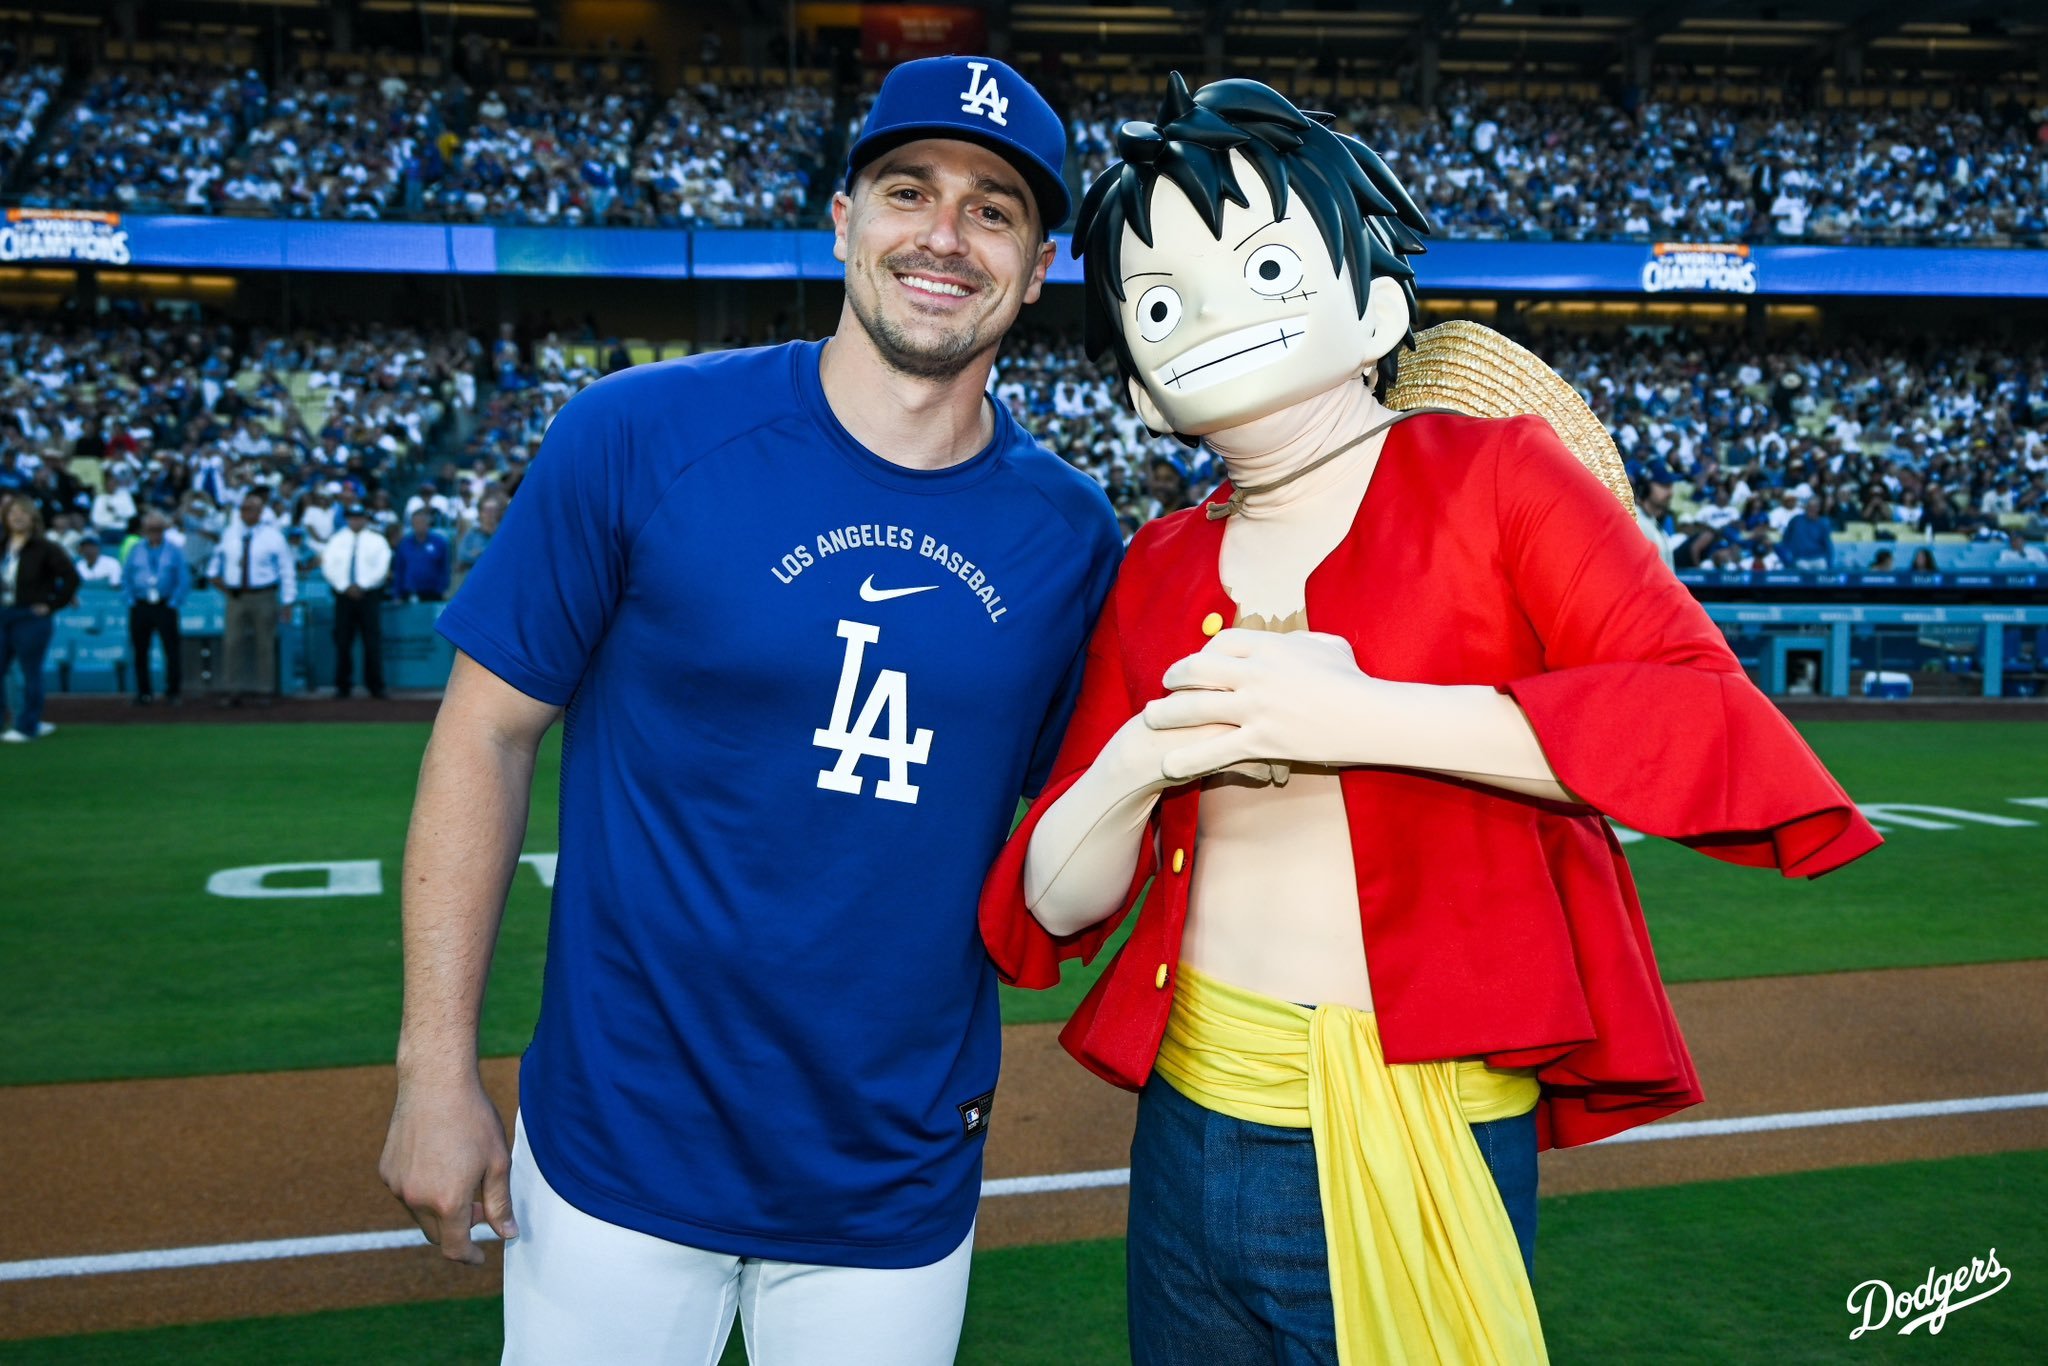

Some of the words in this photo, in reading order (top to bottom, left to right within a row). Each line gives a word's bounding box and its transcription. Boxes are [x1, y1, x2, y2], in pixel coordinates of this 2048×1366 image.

[960, 62, 1009, 127] LA
[1642, 261, 1757, 294] CHAMPIONS
[771, 544, 814, 584] LOS
[816, 524, 914, 558] ANGELES
[919, 534, 1007, 623] BASEBALL
[812, 619, 934, 805] LA
